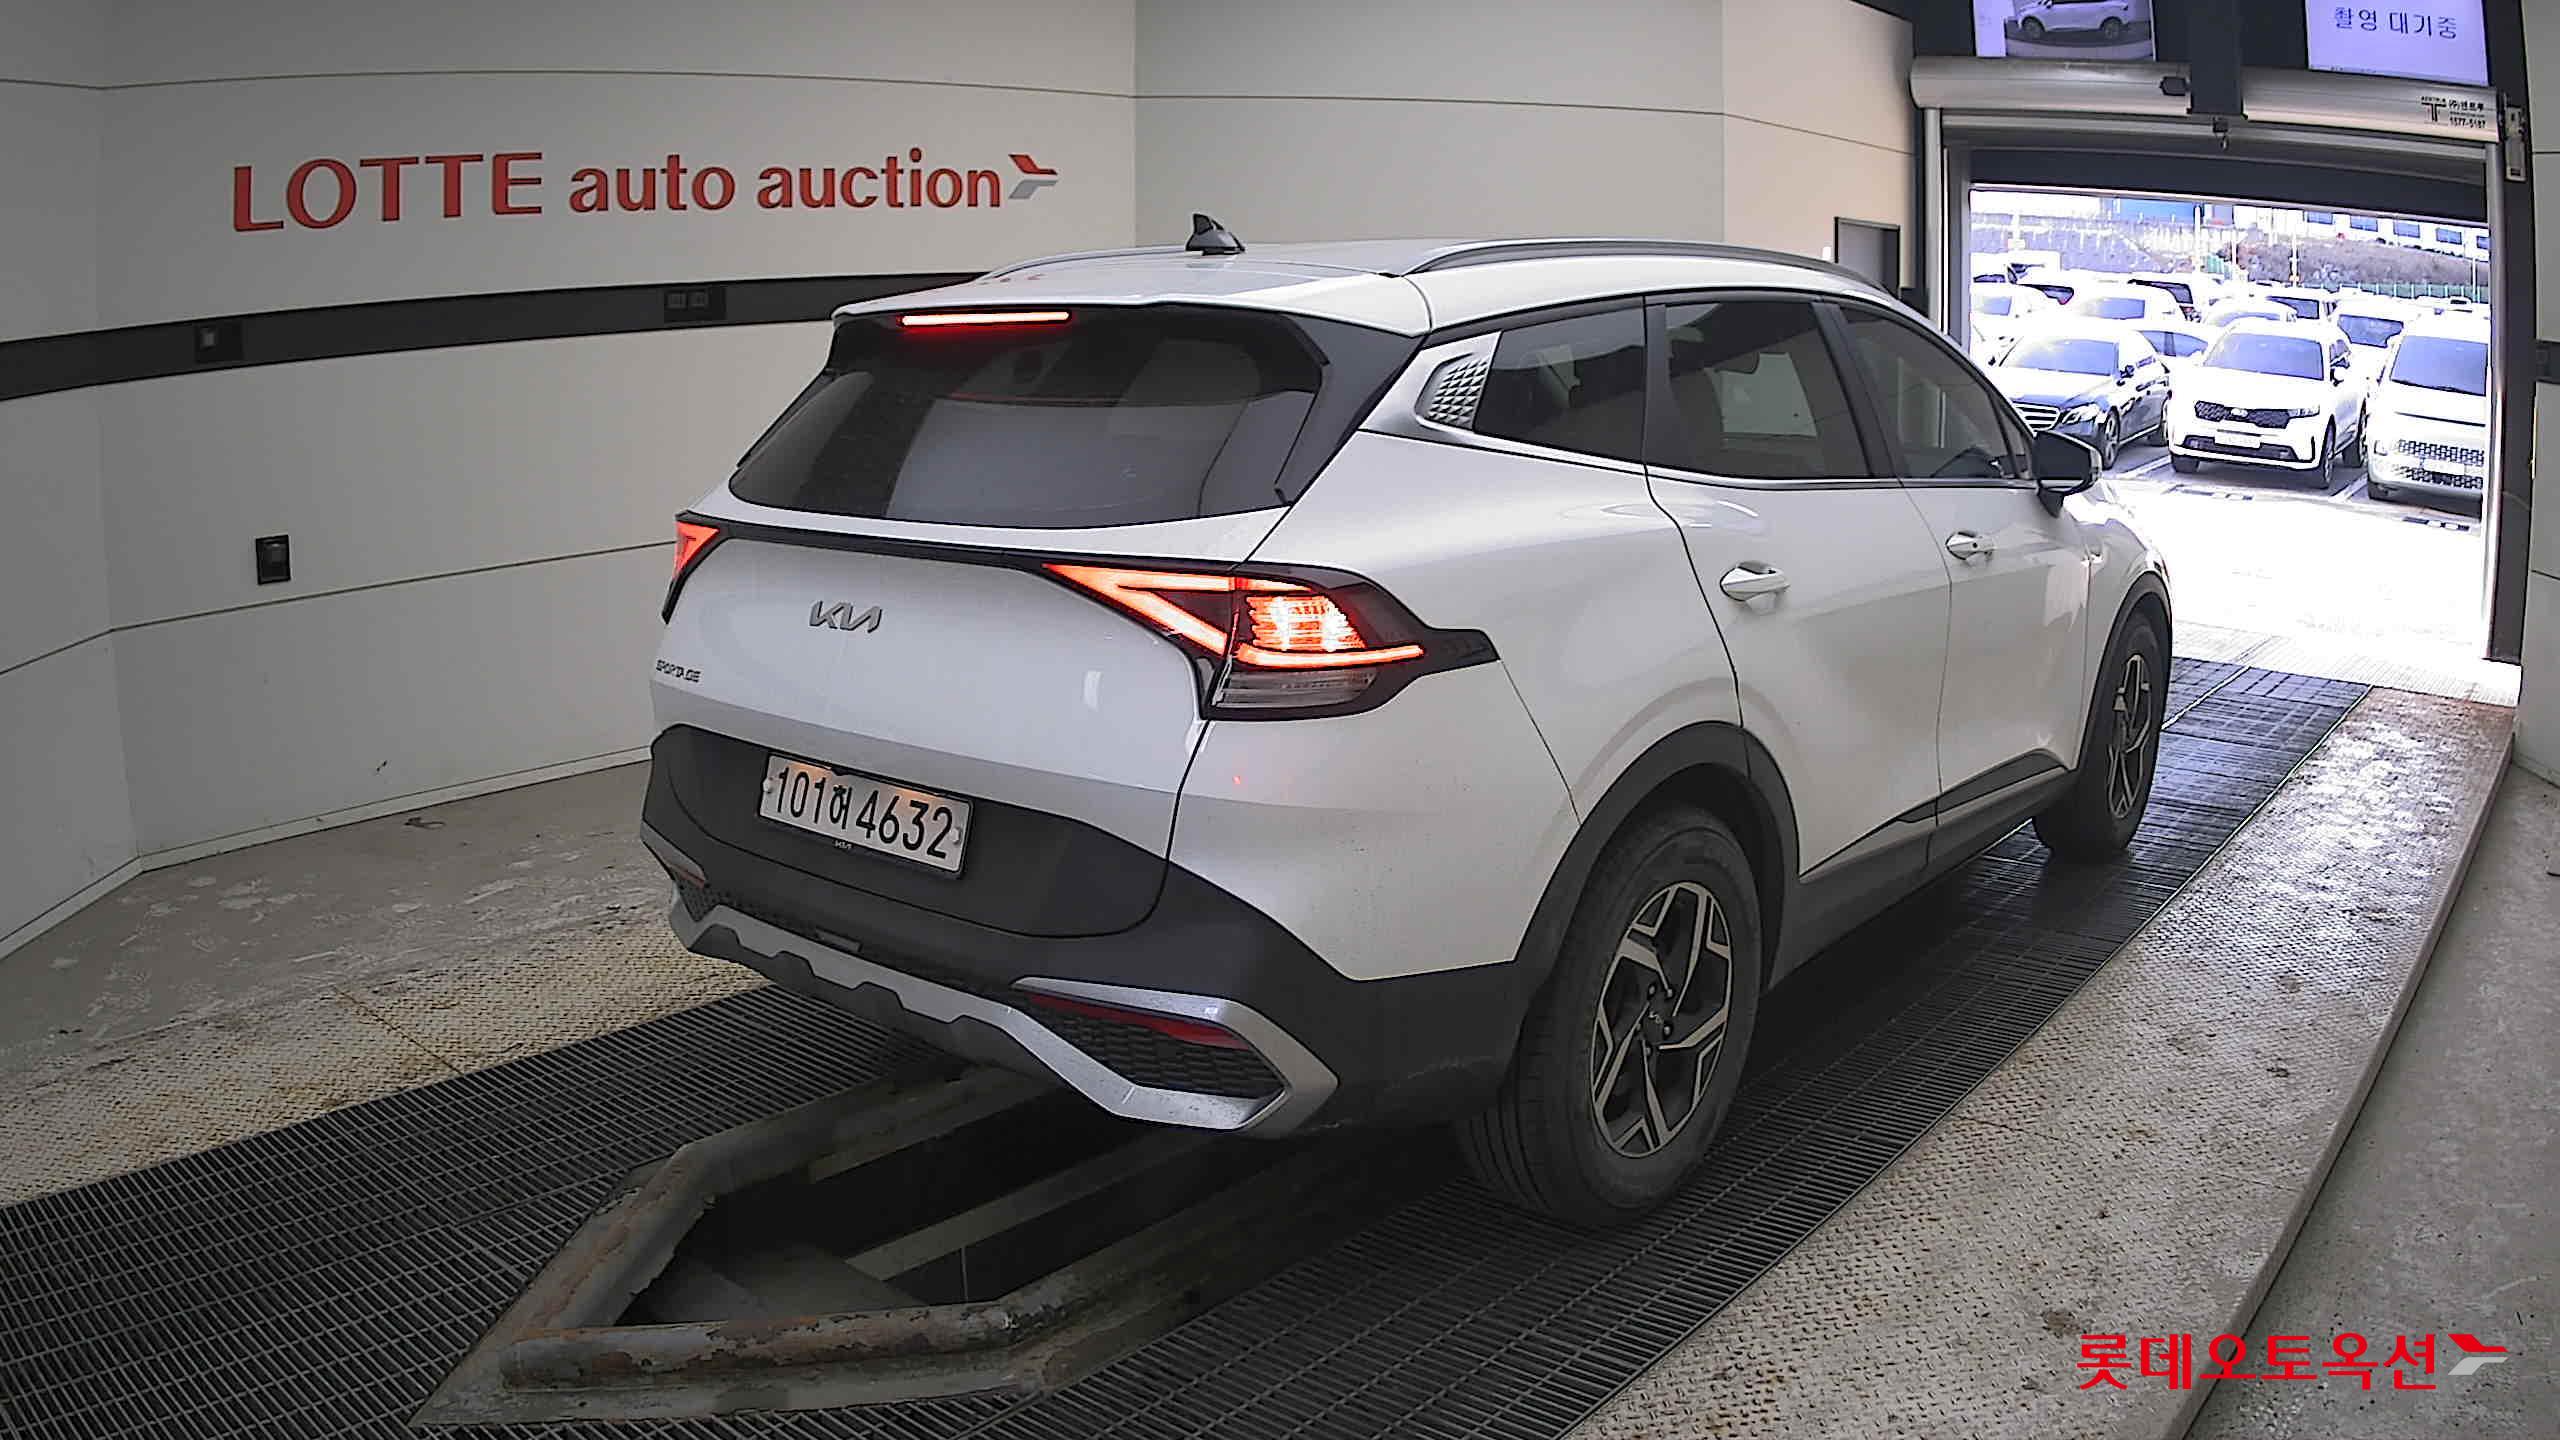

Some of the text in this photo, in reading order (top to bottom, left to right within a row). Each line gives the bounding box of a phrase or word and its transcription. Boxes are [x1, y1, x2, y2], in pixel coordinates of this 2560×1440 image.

[233, 148, 1001, 232] LOTTE auto auction
[810, 601, 882, 633] KIA
[778, 767, 953, 859] 101허4632
